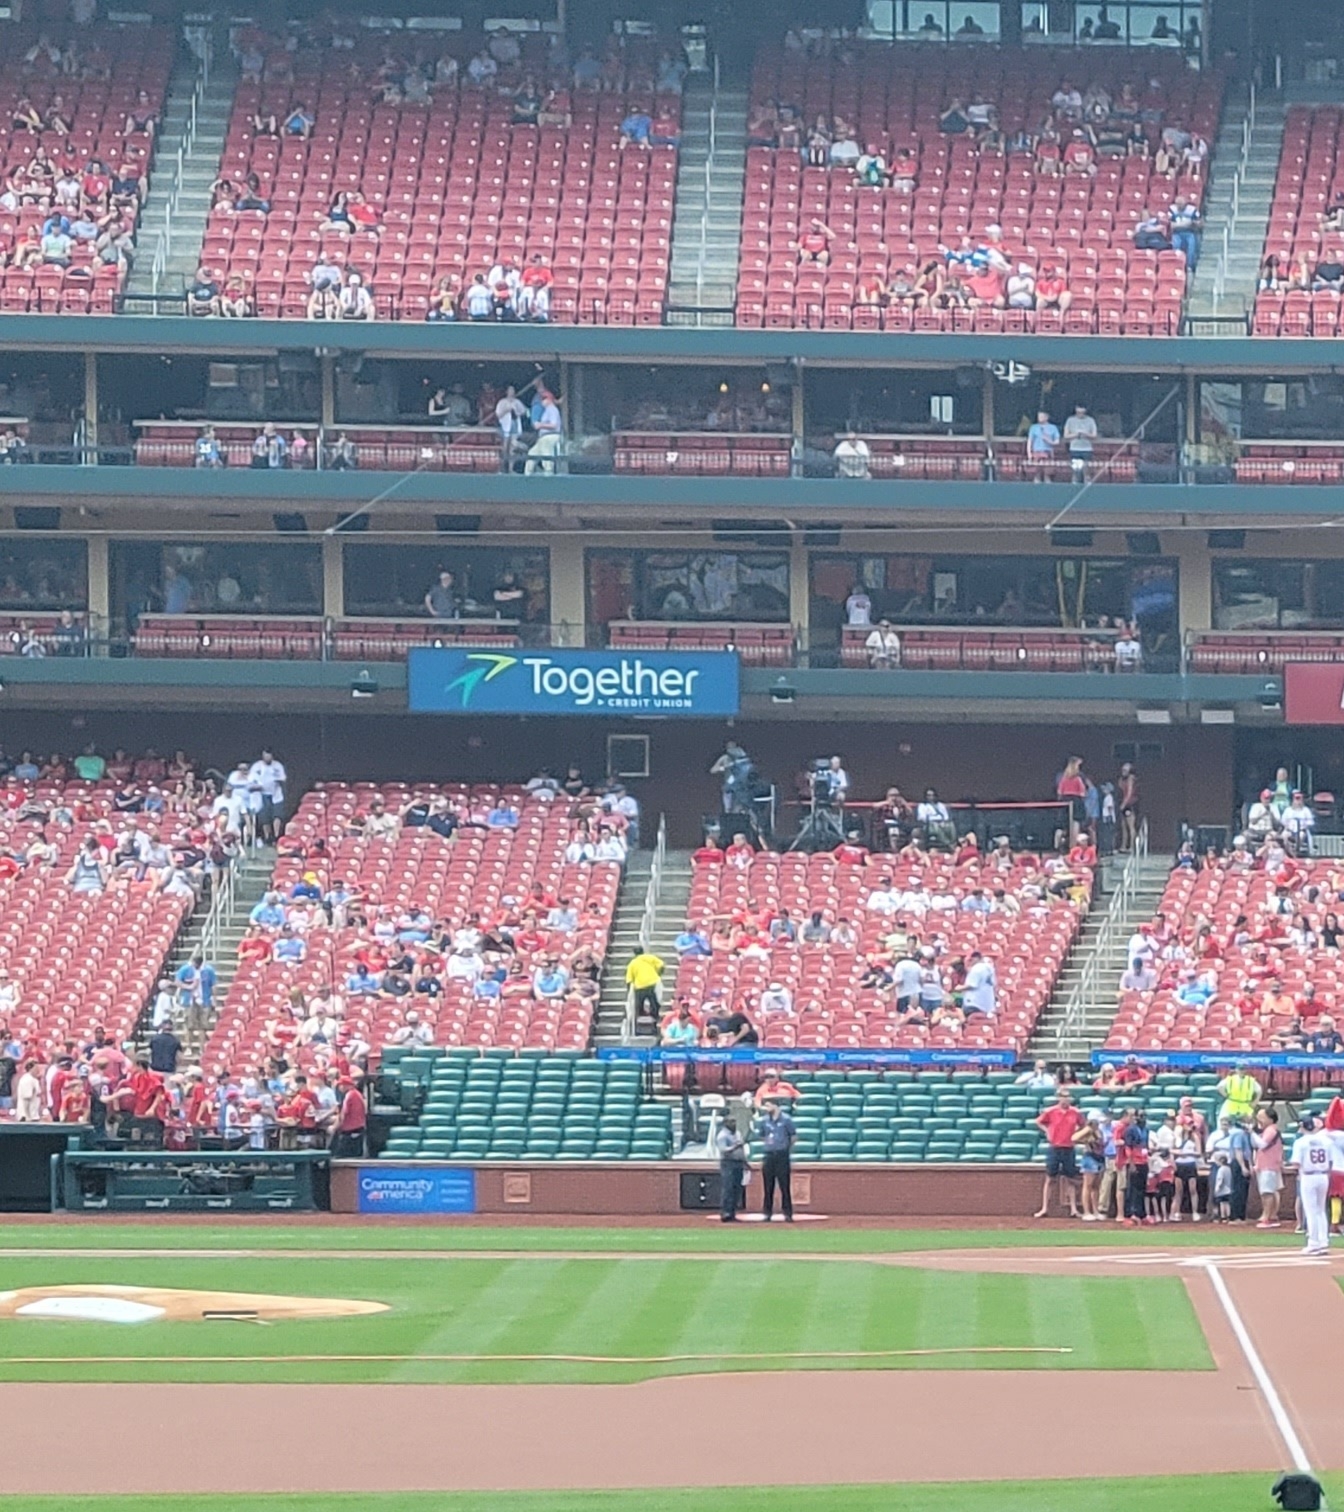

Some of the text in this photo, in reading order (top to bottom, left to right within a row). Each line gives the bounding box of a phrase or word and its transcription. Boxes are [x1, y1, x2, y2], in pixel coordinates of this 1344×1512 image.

[522, 657, 699, 705] Together
[607, 698, 692, 708] CREDIT UNION
[361, 1177, 434, 1194] Community
